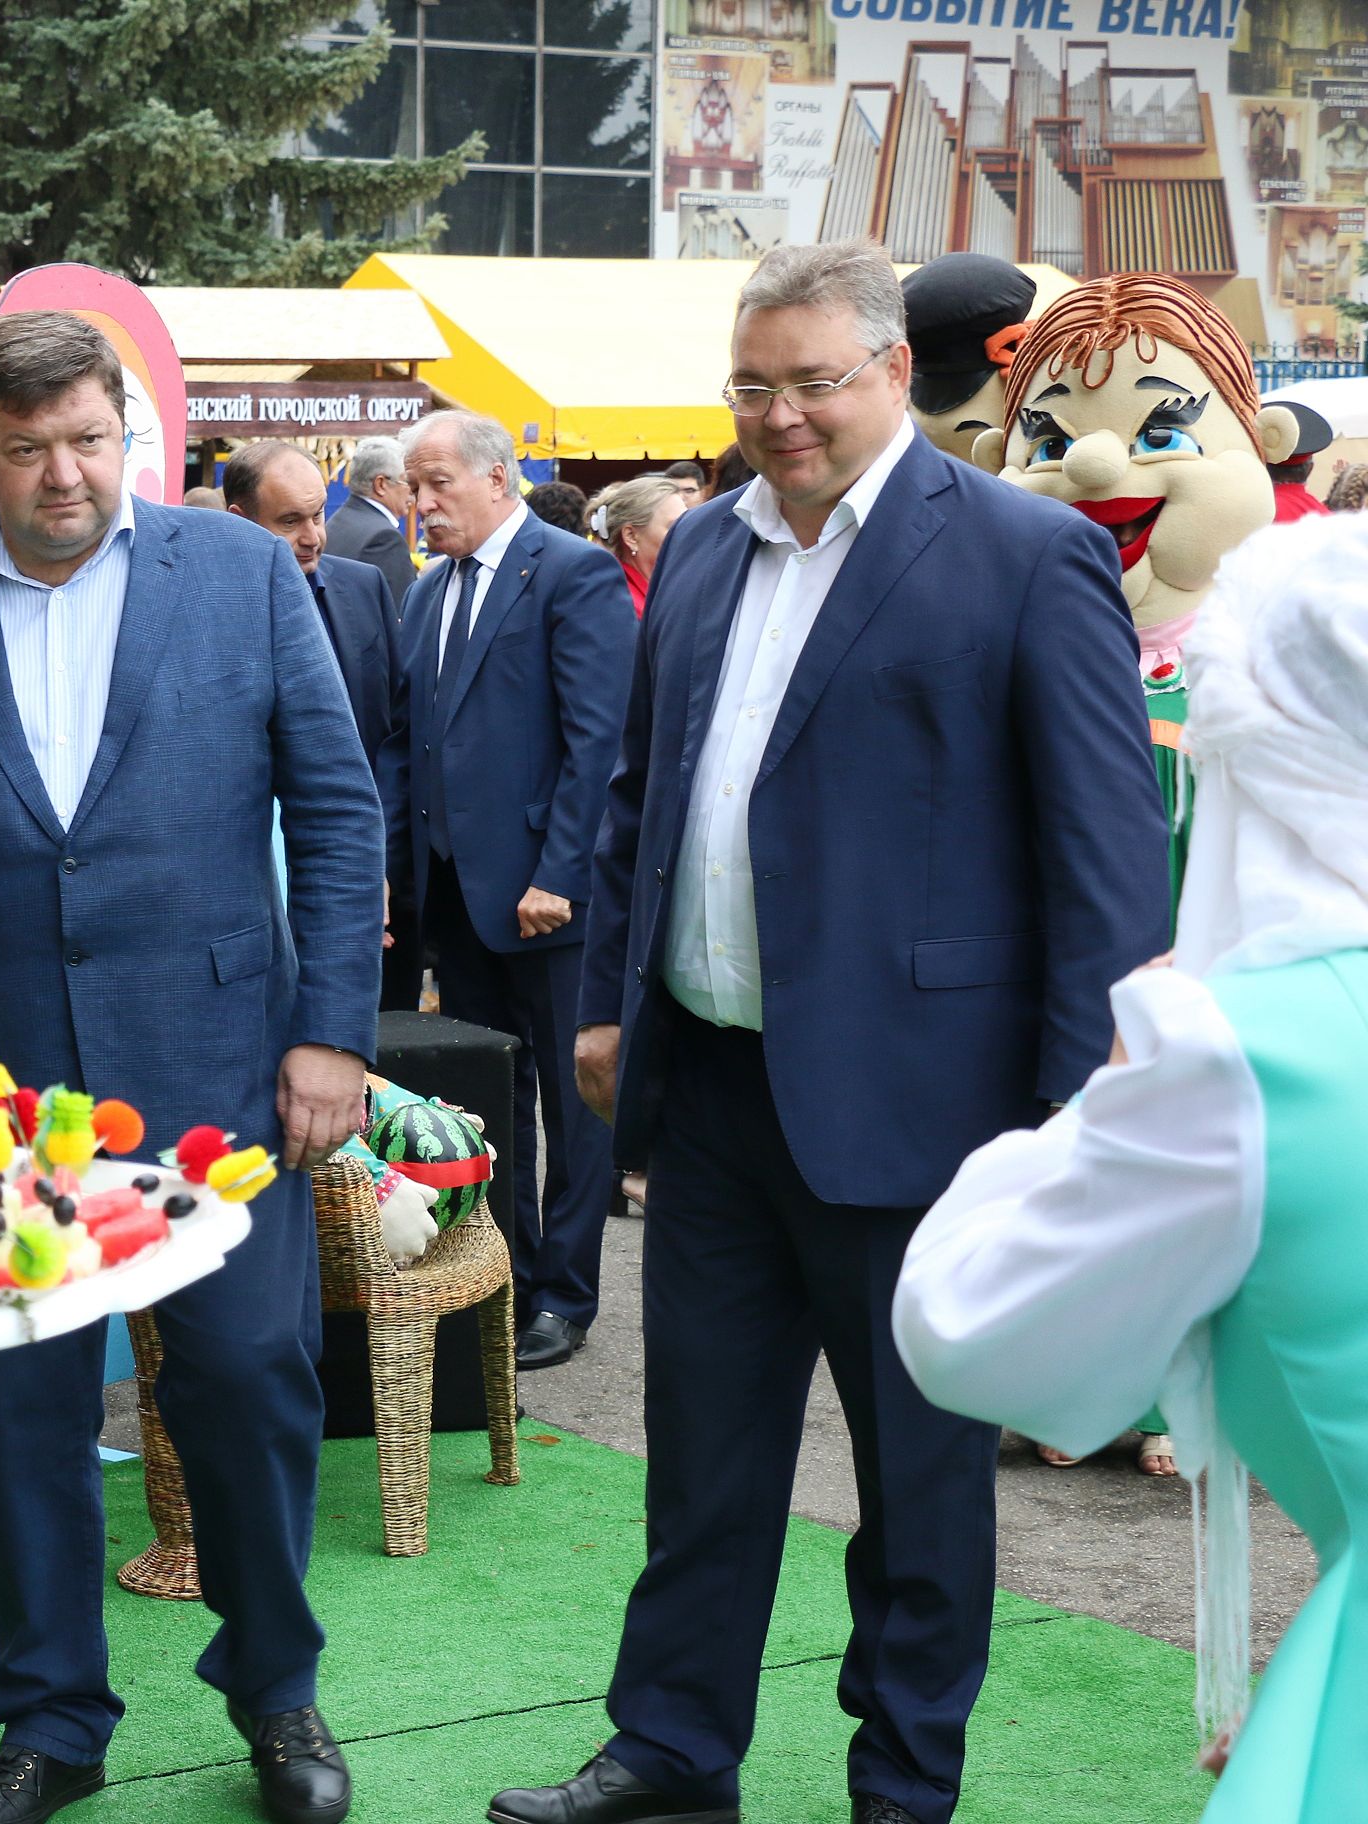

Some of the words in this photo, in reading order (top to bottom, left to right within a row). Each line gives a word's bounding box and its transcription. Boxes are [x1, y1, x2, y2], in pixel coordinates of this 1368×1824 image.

[1098, 0, 1238, 39] ВЕКА!
[259, 394, 362, 426] ГОРОДСКОЙ
[367, 398, 424, 421] ОКРУГ
